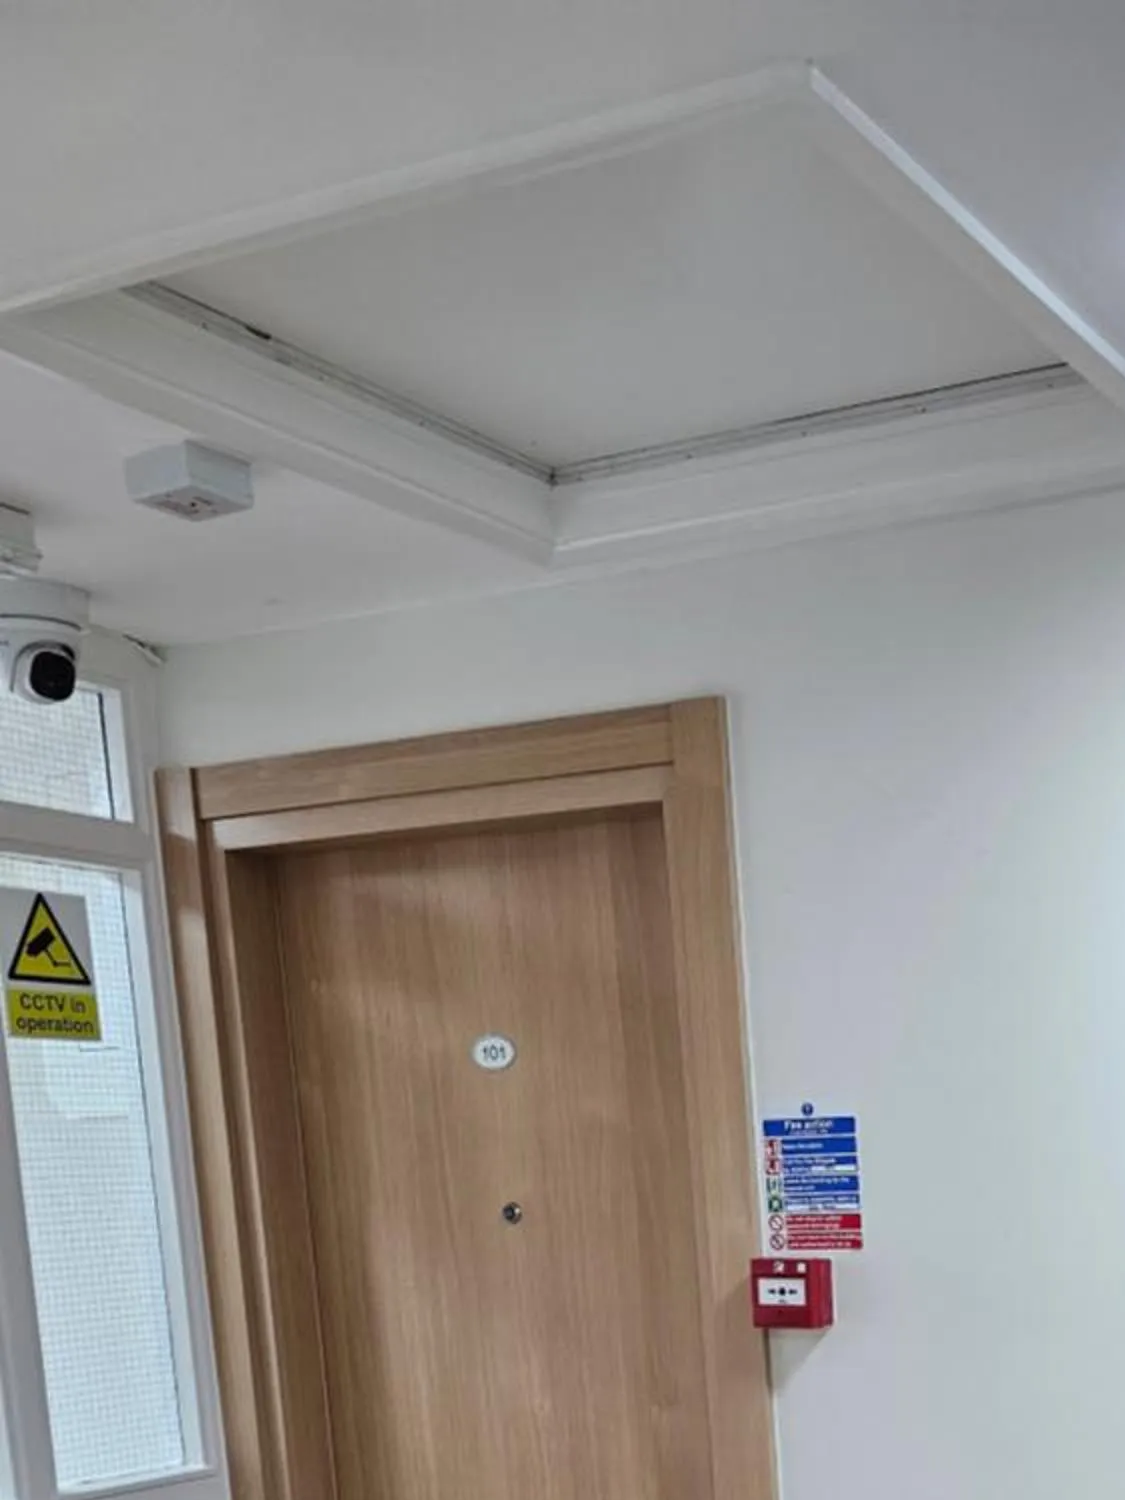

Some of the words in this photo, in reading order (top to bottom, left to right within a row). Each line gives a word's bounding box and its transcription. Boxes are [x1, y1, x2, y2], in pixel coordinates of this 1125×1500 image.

[19, 992, 66, 1013] CCTV
[71, 997, 87, 1014] in
[16, 1015, 94, 1035] operation
[482, 1044, 506, 1061] 101
